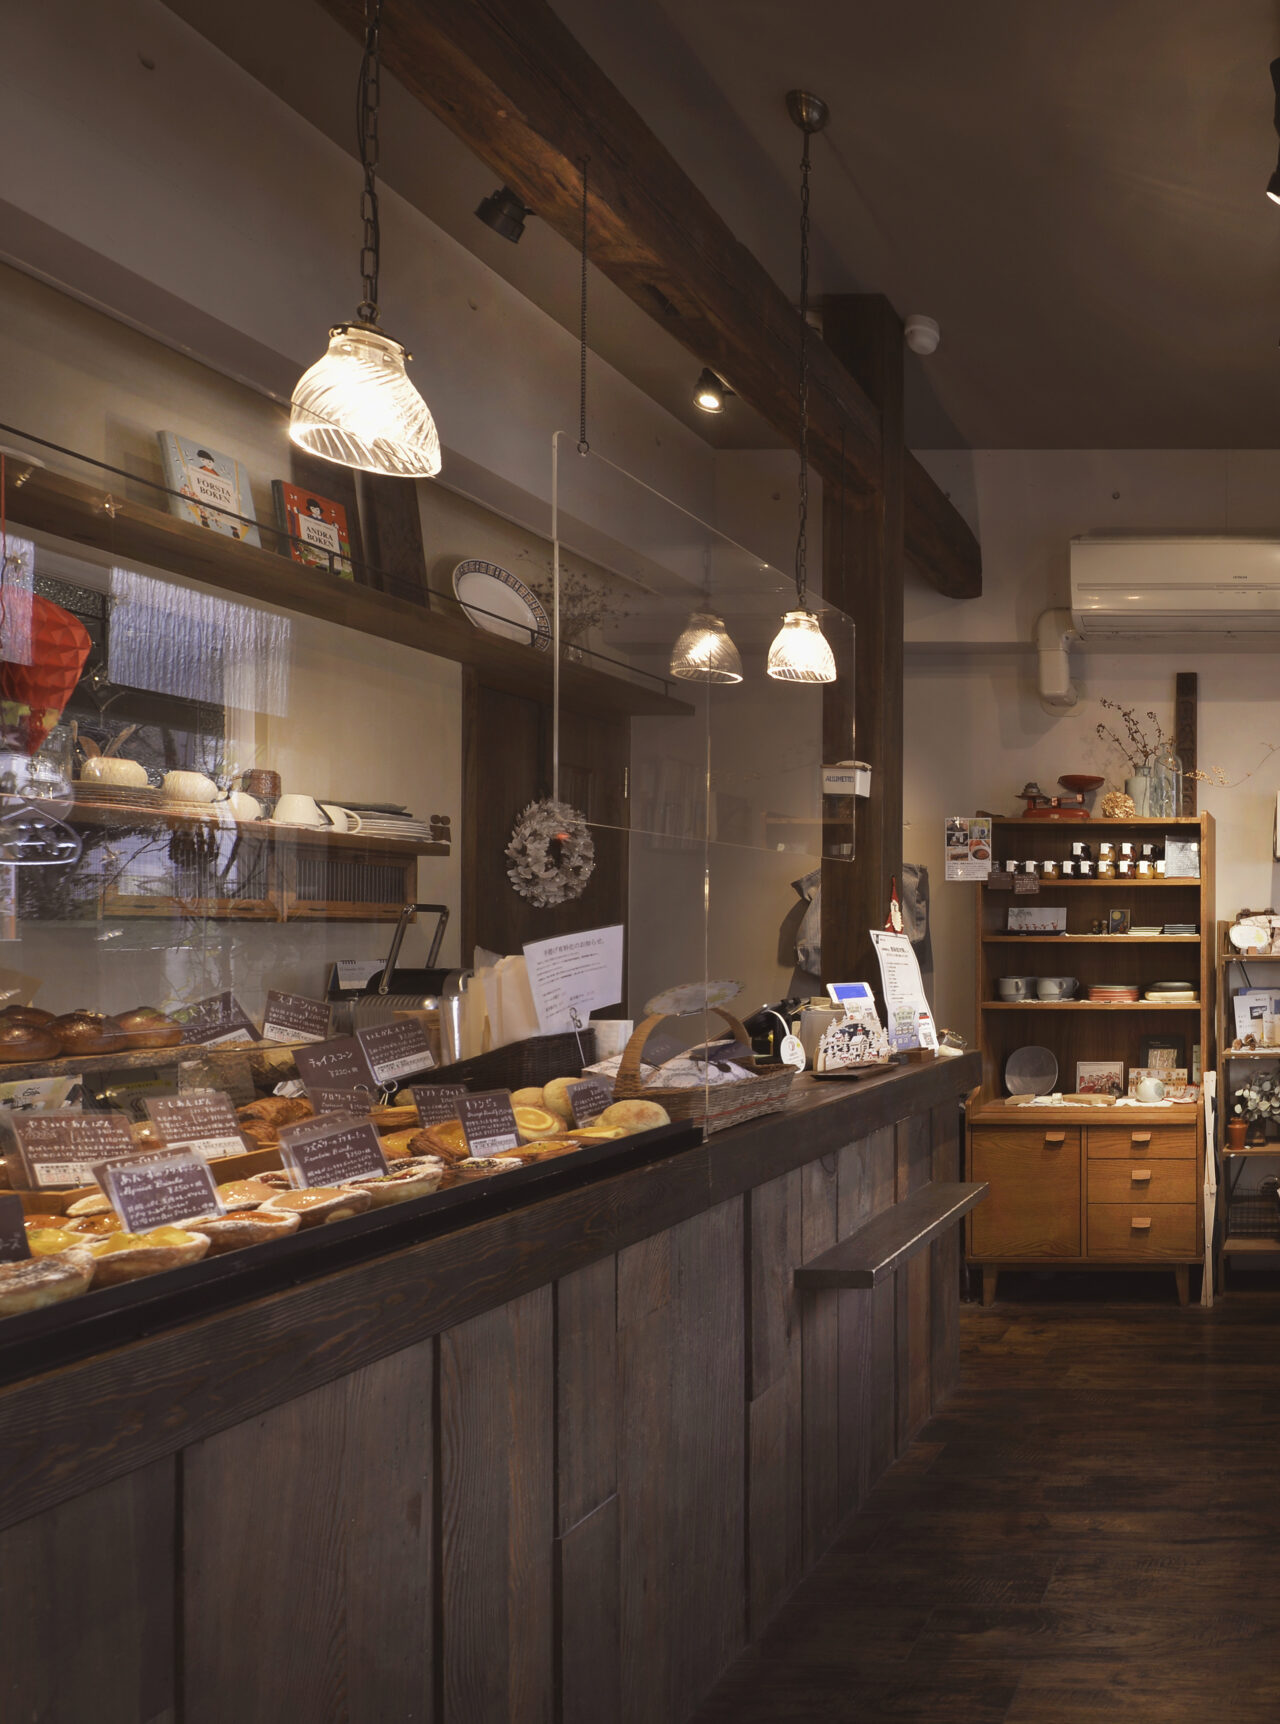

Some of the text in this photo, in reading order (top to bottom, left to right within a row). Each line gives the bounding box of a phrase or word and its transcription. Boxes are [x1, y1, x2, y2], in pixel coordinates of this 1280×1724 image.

[199, 486, 231, 504] BOKEN
[306, 526, 334, 541] ANDRA
[307, 533, 334, 547] BOKEN
[308, 1051, 353, 1068] チャイスコーン
[157, 1098, 212, 1110] こしあんぱん
